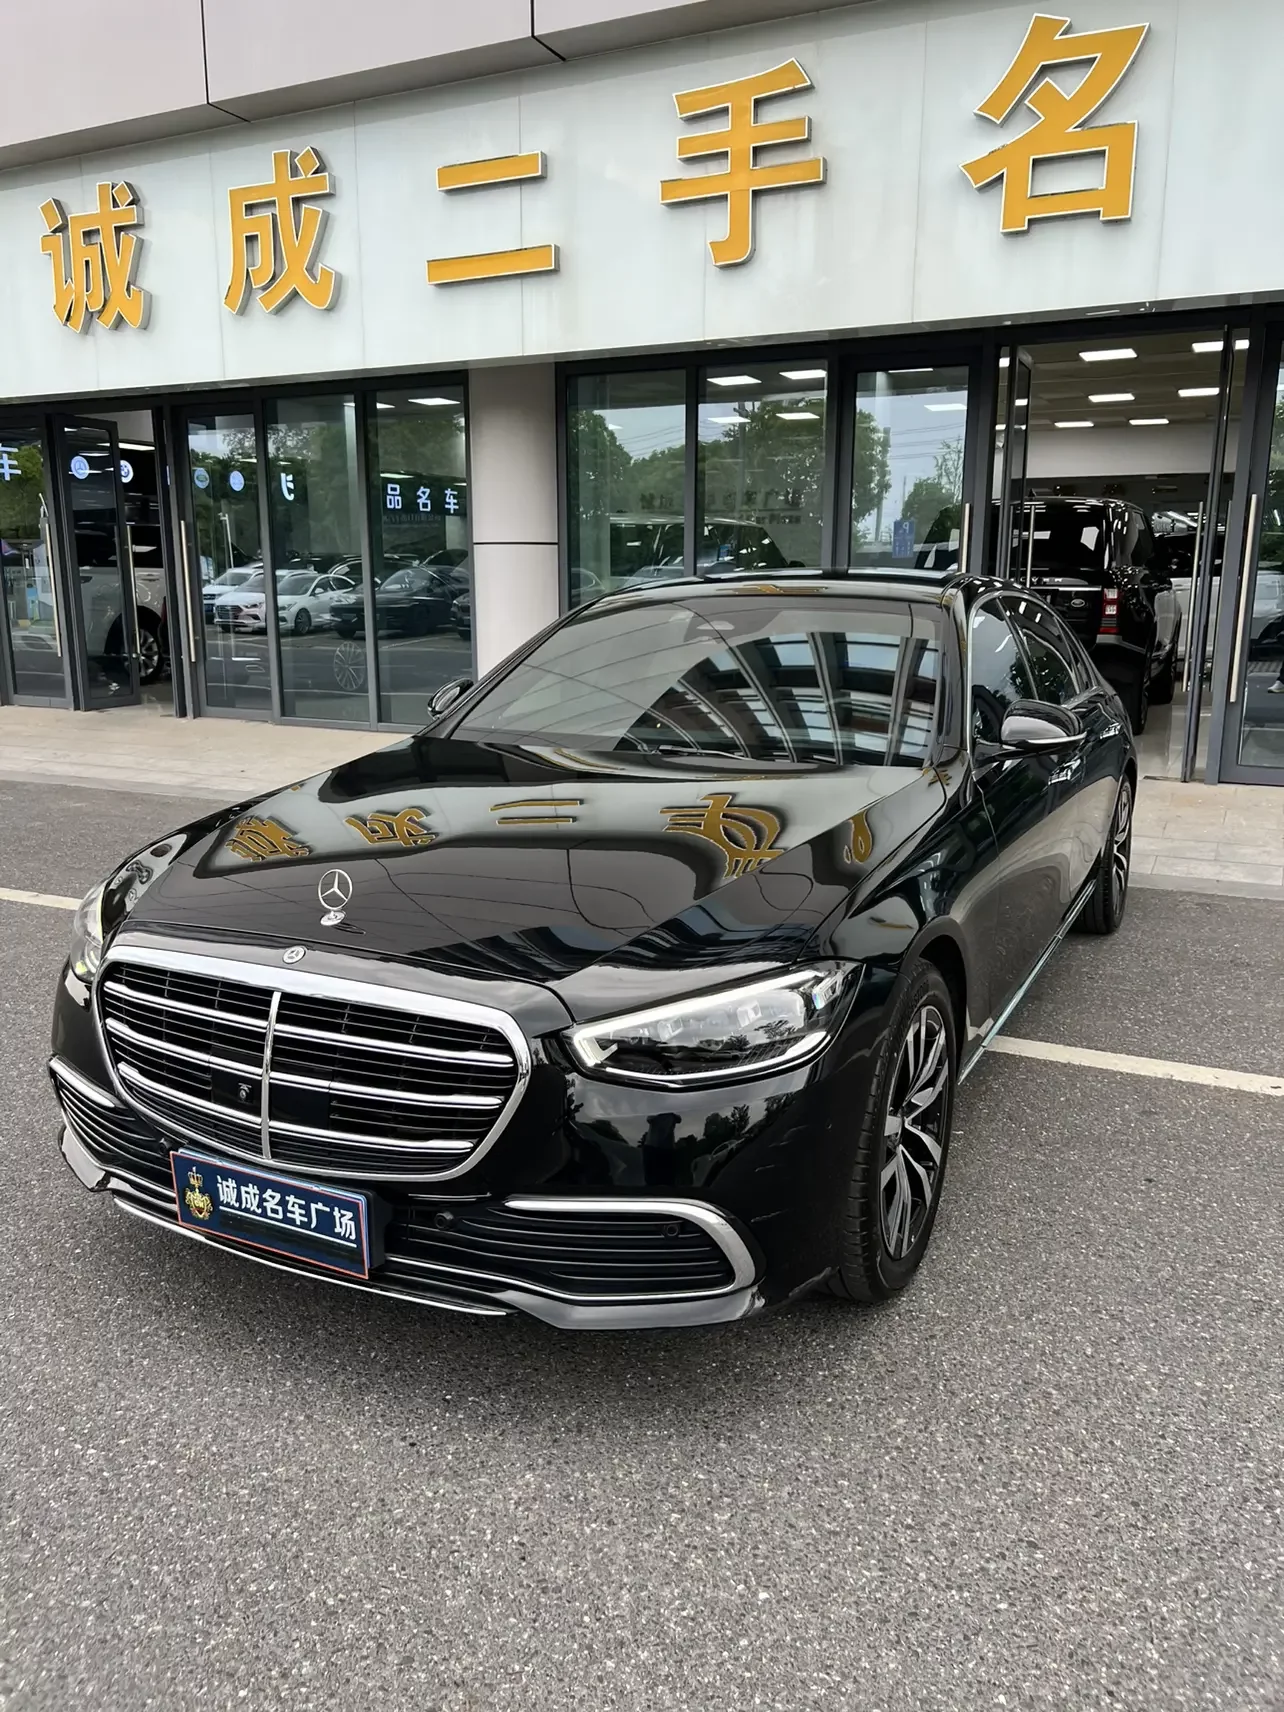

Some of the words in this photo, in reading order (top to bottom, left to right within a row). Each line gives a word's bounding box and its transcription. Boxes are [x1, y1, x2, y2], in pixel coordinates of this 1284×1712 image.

[38, 13, 1151, 333] 诚成二手名
[387, 483, 459, 514] 品名车
[216, 1175, 357, 1240] 诚成名车广场
